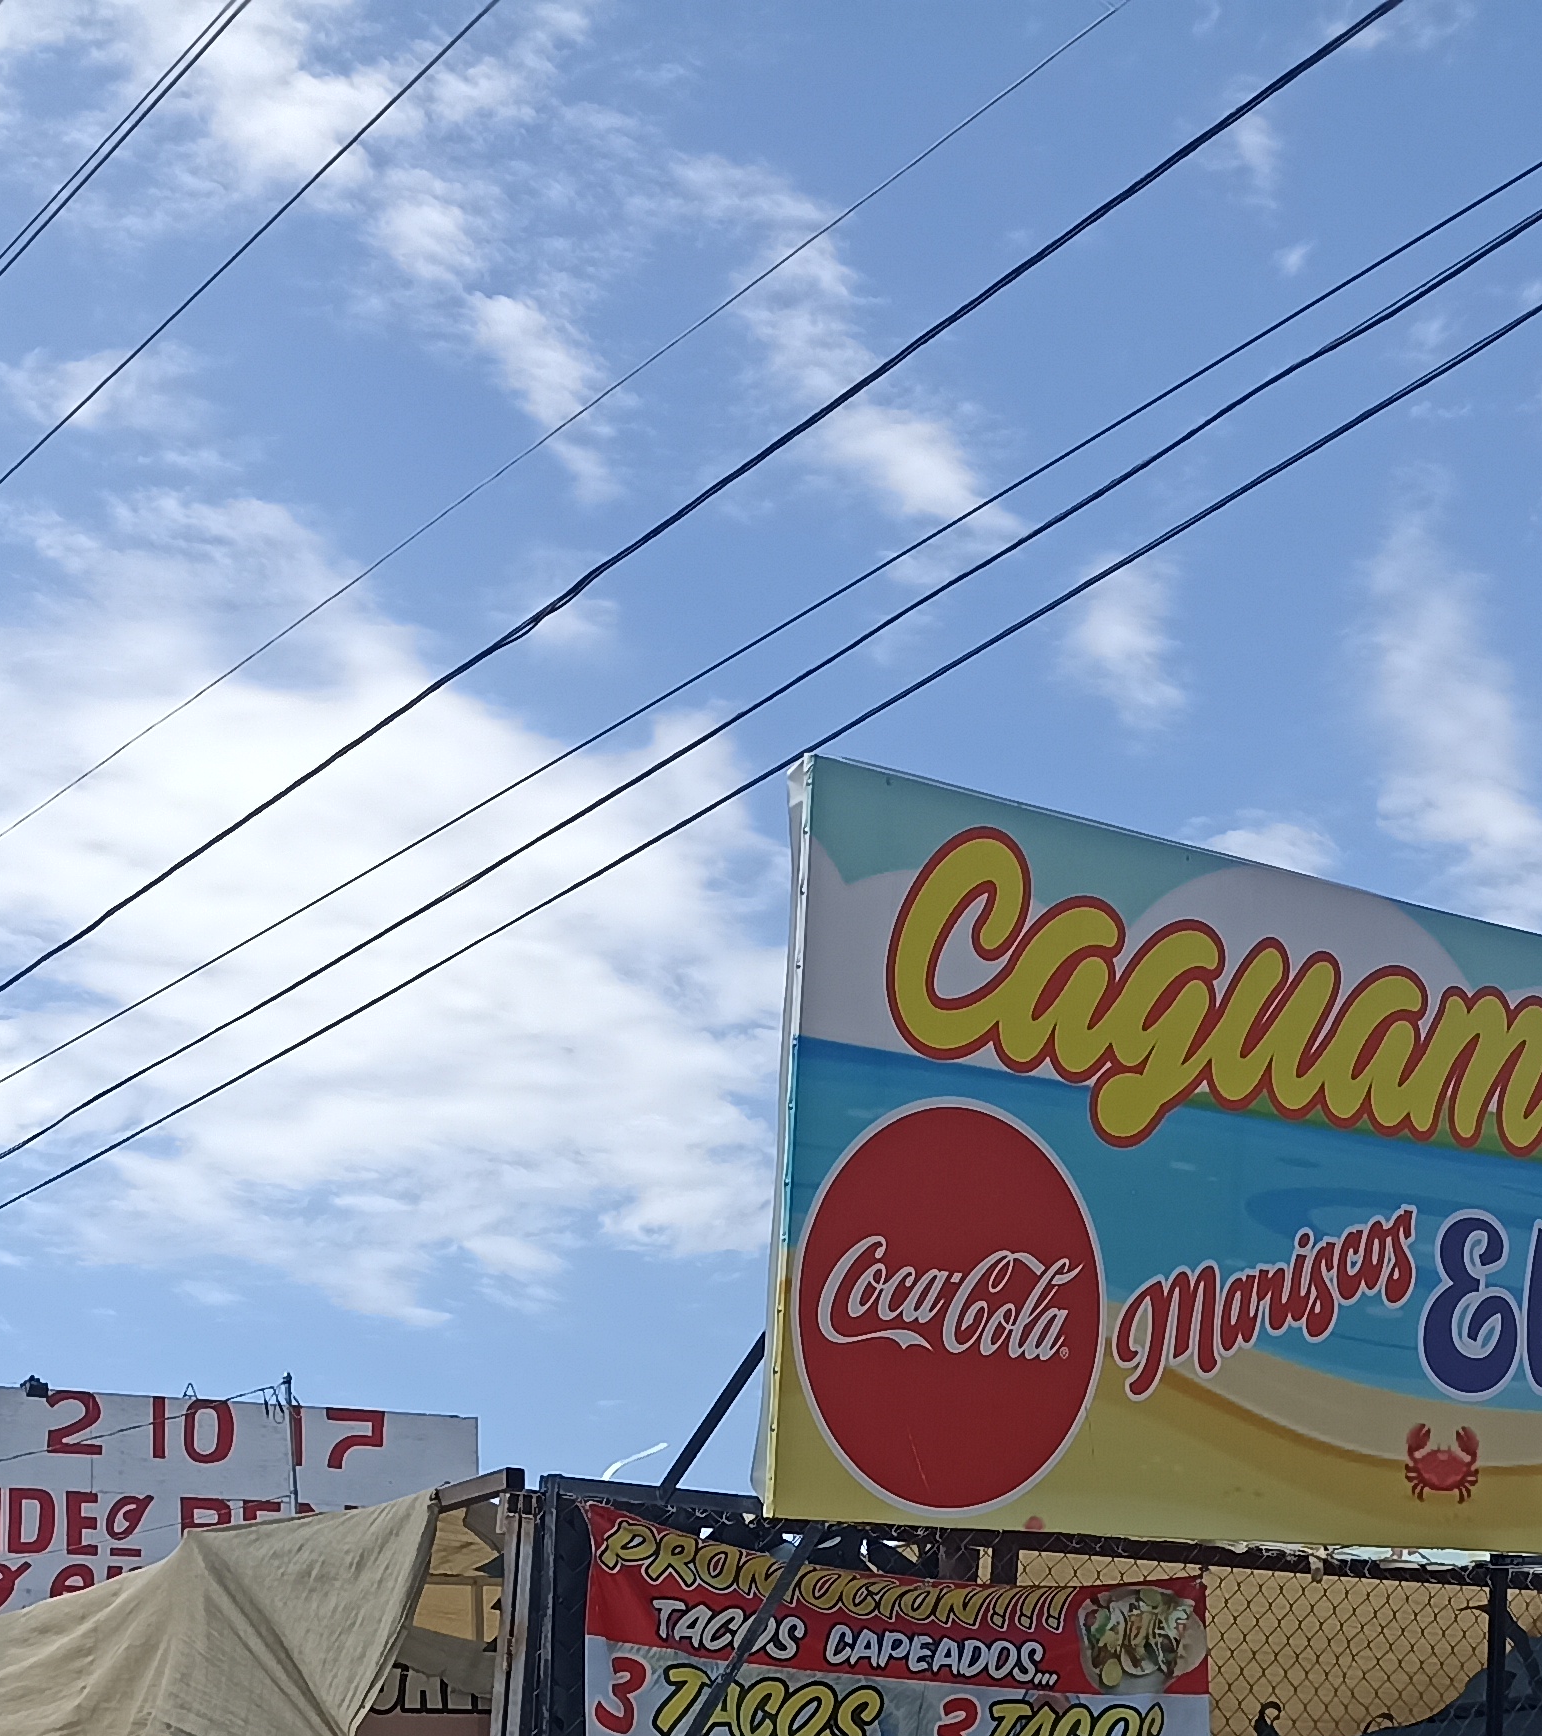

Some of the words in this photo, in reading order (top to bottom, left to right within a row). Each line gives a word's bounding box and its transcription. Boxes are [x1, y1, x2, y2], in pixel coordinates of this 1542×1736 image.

[817, 1235, 1085, 1361] Coca-Cola
[1110, 1202, 1415, 1398] Mariscos
[47, 1390, 102, 1455] 2
[594, 1656, 648, 1734] 3
